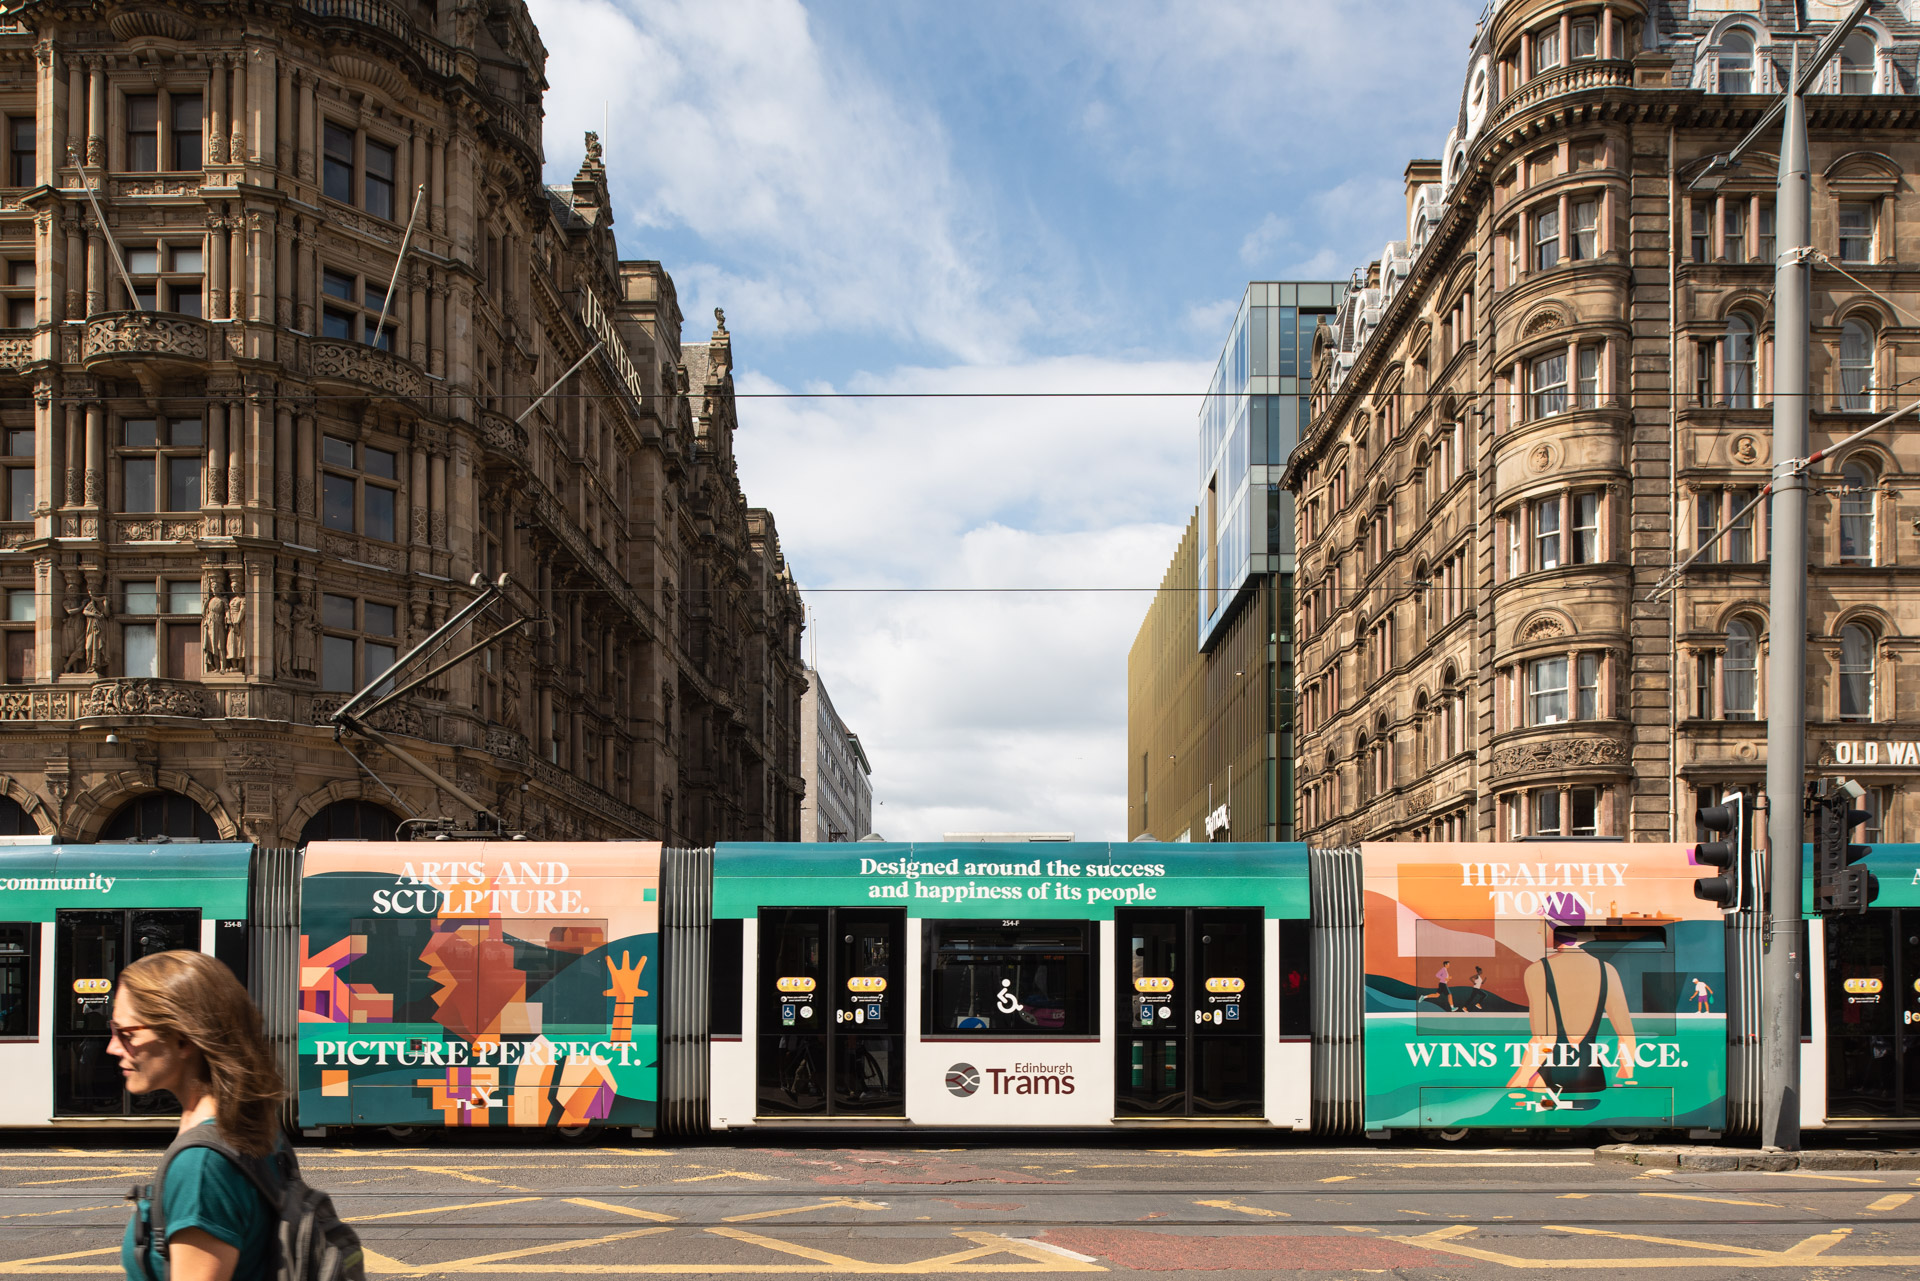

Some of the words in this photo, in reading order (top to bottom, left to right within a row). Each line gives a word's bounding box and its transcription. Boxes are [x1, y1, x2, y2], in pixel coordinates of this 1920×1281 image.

[581, 283, 642, 406] JENNERS
[1836, 741, 1879, 764] OLD
[395, 861, 486, 885] ARTS
[493, 861, 570, 885] AND
[860, 857, 960, 880] Designed
[964, 859, 1042, 876] around
[1046, 859, 1081, 877] the
[1085, 863, 1166, 877] success
[1460, 862, 1629, 887] HEALTHY
[0, 872, 116, 894] community
[868, 881, 910, 898] and
[914, 881, 1023, 903] happiness
[1027, 882, 1053, 900] of
[1054, 882, 1082, 900] its
[1087, 883, 1157, 905] people
[372, 889, 590, 914] SCULPTURE.
[1489, 890, 1603, 915] TOWN.
[1002, 919, 1020, 927] 254-F
[314, 1041, 468, 1066] PICTURE
[476, 1041, 641, 1066] PERFECT.
[1405, 1042, 1497, 1068] WINS
[1504, 1042, 1580, 1068] THE
[1588, 1042, 1689, 1068] RACE.
[1014, 1062, 1073, 1075] Edinburgh
[985, 1067, 1075, 1095] Trams
